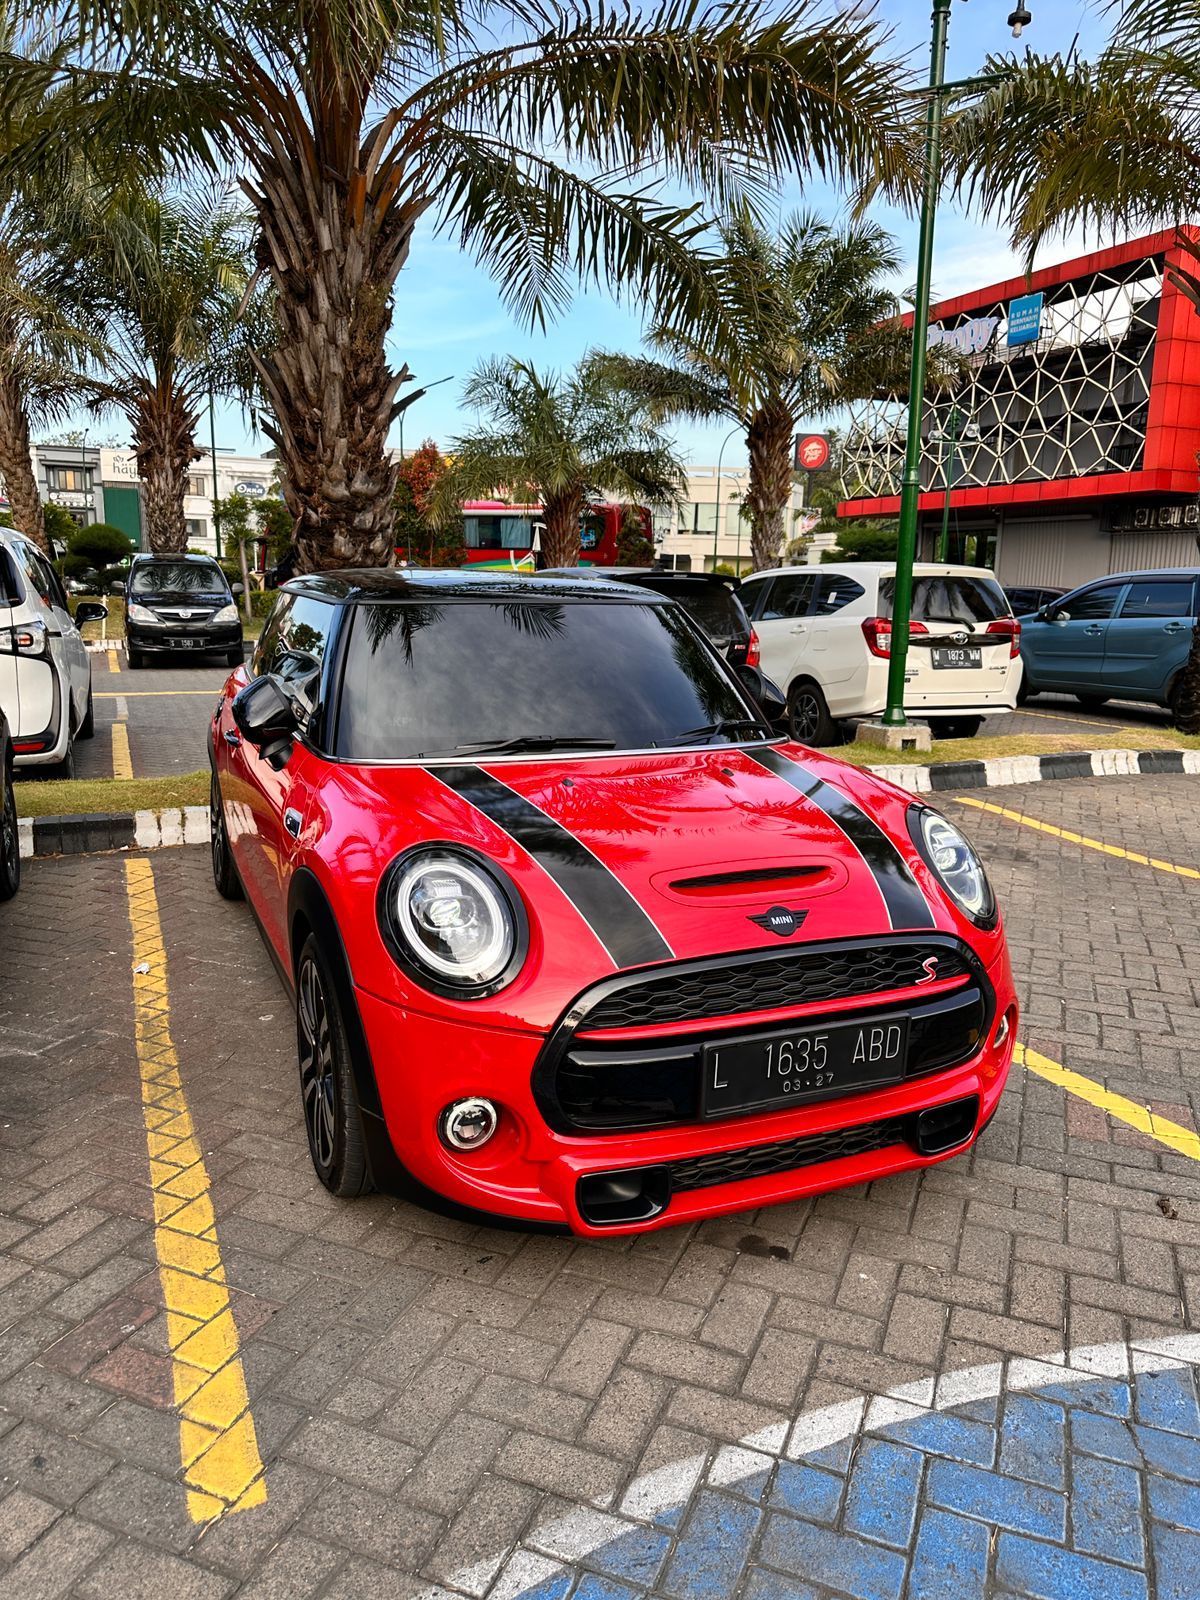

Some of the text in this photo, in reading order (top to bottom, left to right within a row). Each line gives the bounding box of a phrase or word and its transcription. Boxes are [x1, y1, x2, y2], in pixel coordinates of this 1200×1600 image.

[947, 650, 965, 661] 1873
[771, 915, 793, 925] MINI
[915, 956, 938, 985] S
[714, 1026, 901, 1089] L 1635 ABD
